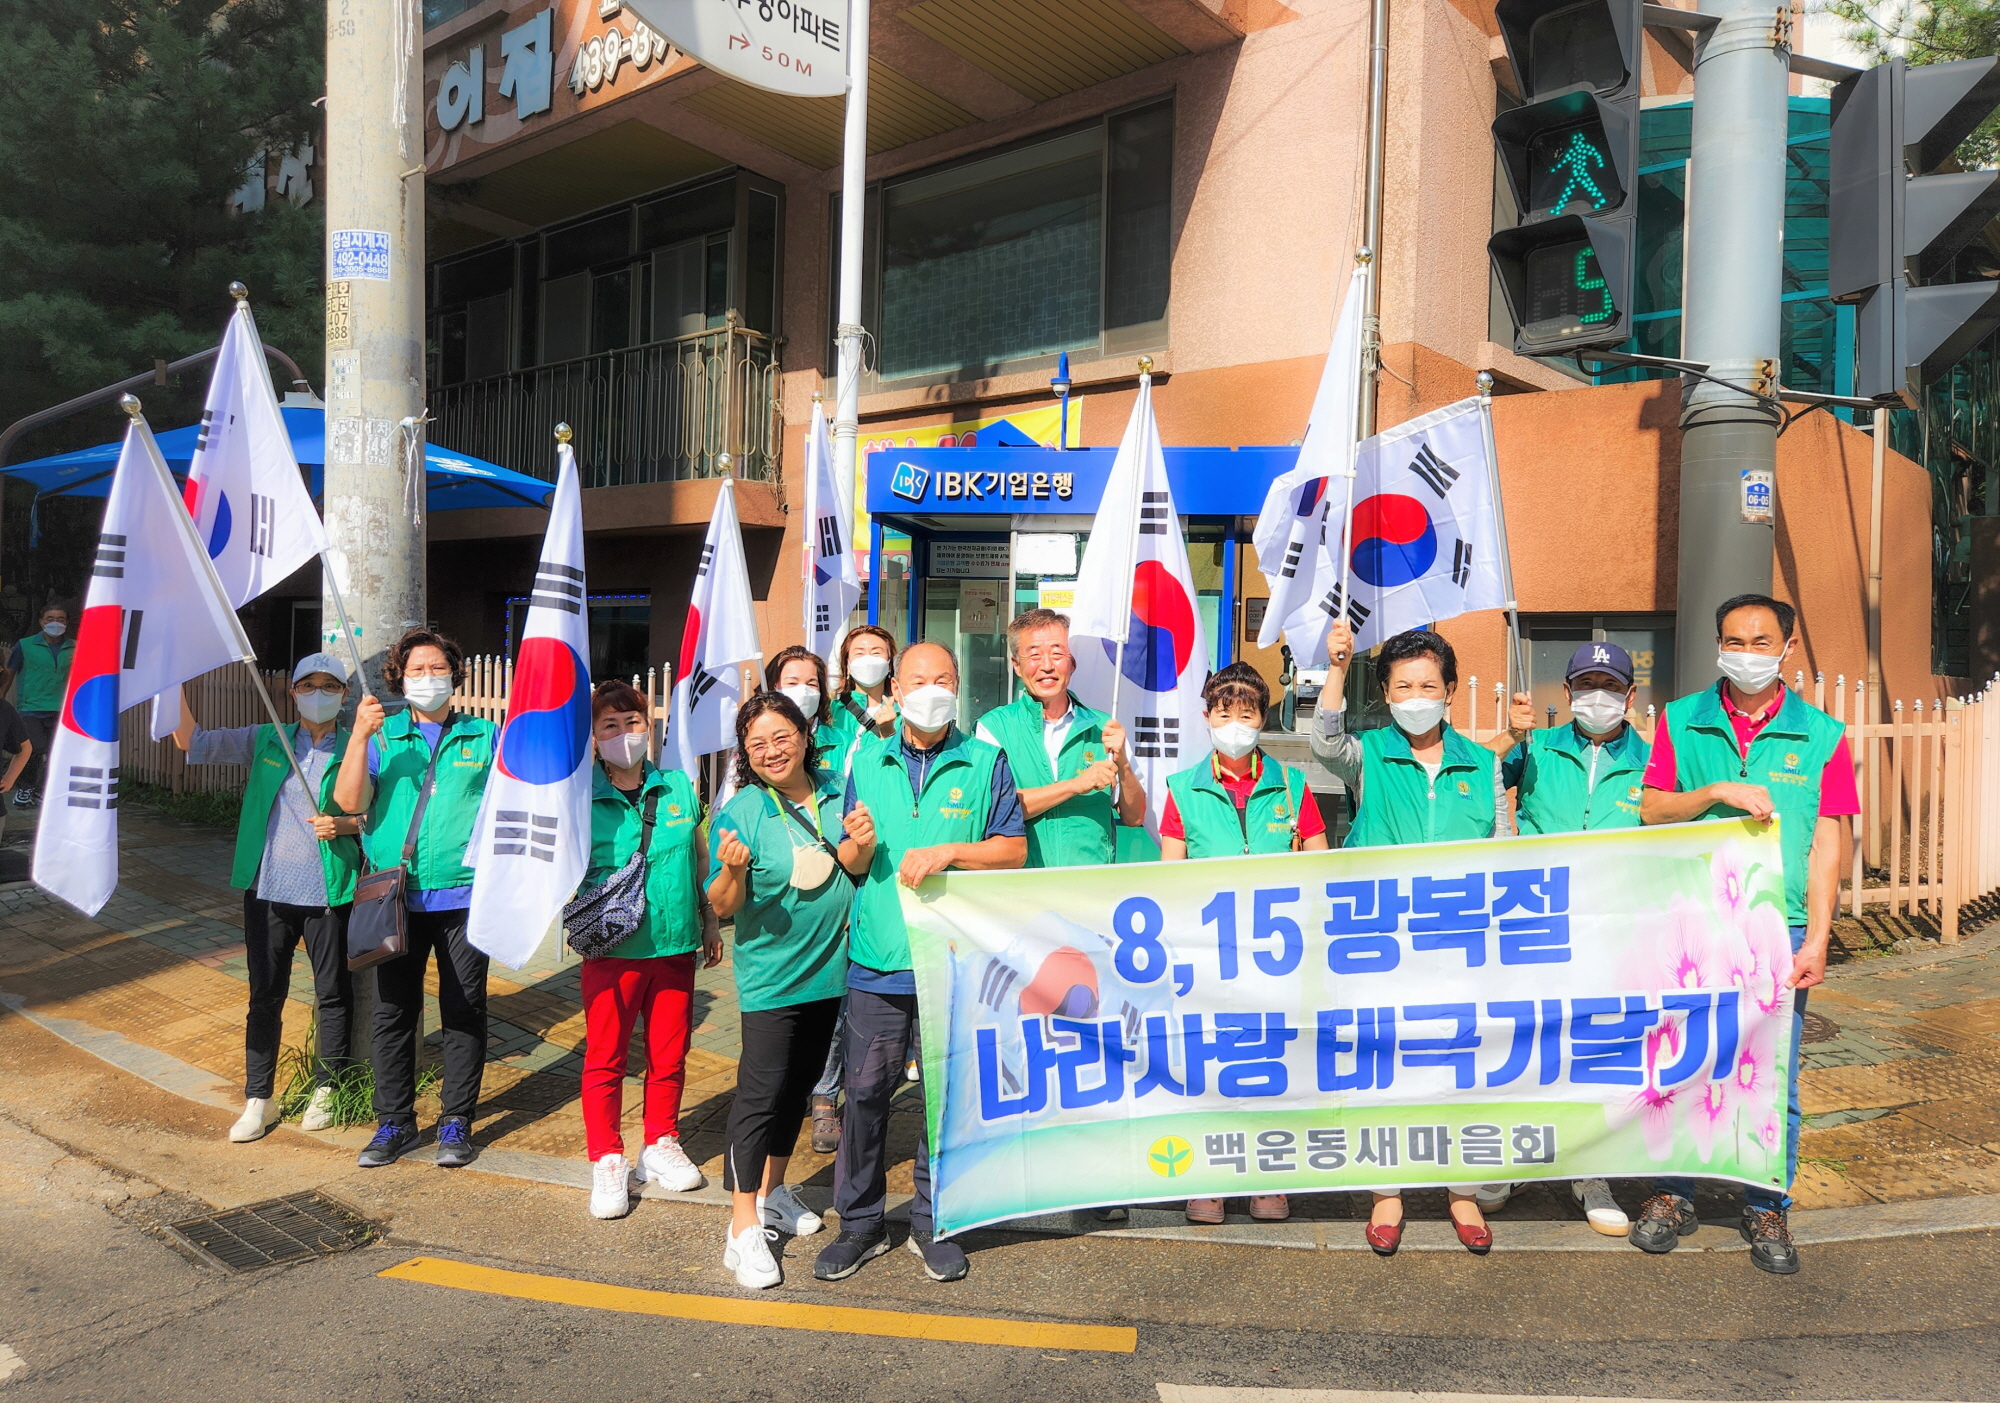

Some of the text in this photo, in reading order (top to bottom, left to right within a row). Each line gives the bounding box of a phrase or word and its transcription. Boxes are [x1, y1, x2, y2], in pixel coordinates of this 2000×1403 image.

[336, 251, 388, 268] 492-0448
[935, 472, 1074, 498] IBK기업은행
[1592, 645, 1611, 664] LA
[1323, 865, 1572, 975] 광복절
[975, 990, 1741, 1122] 나라사랑 태극기달기
[1204, 1123, 1557, 1173] 백운동새마을회
